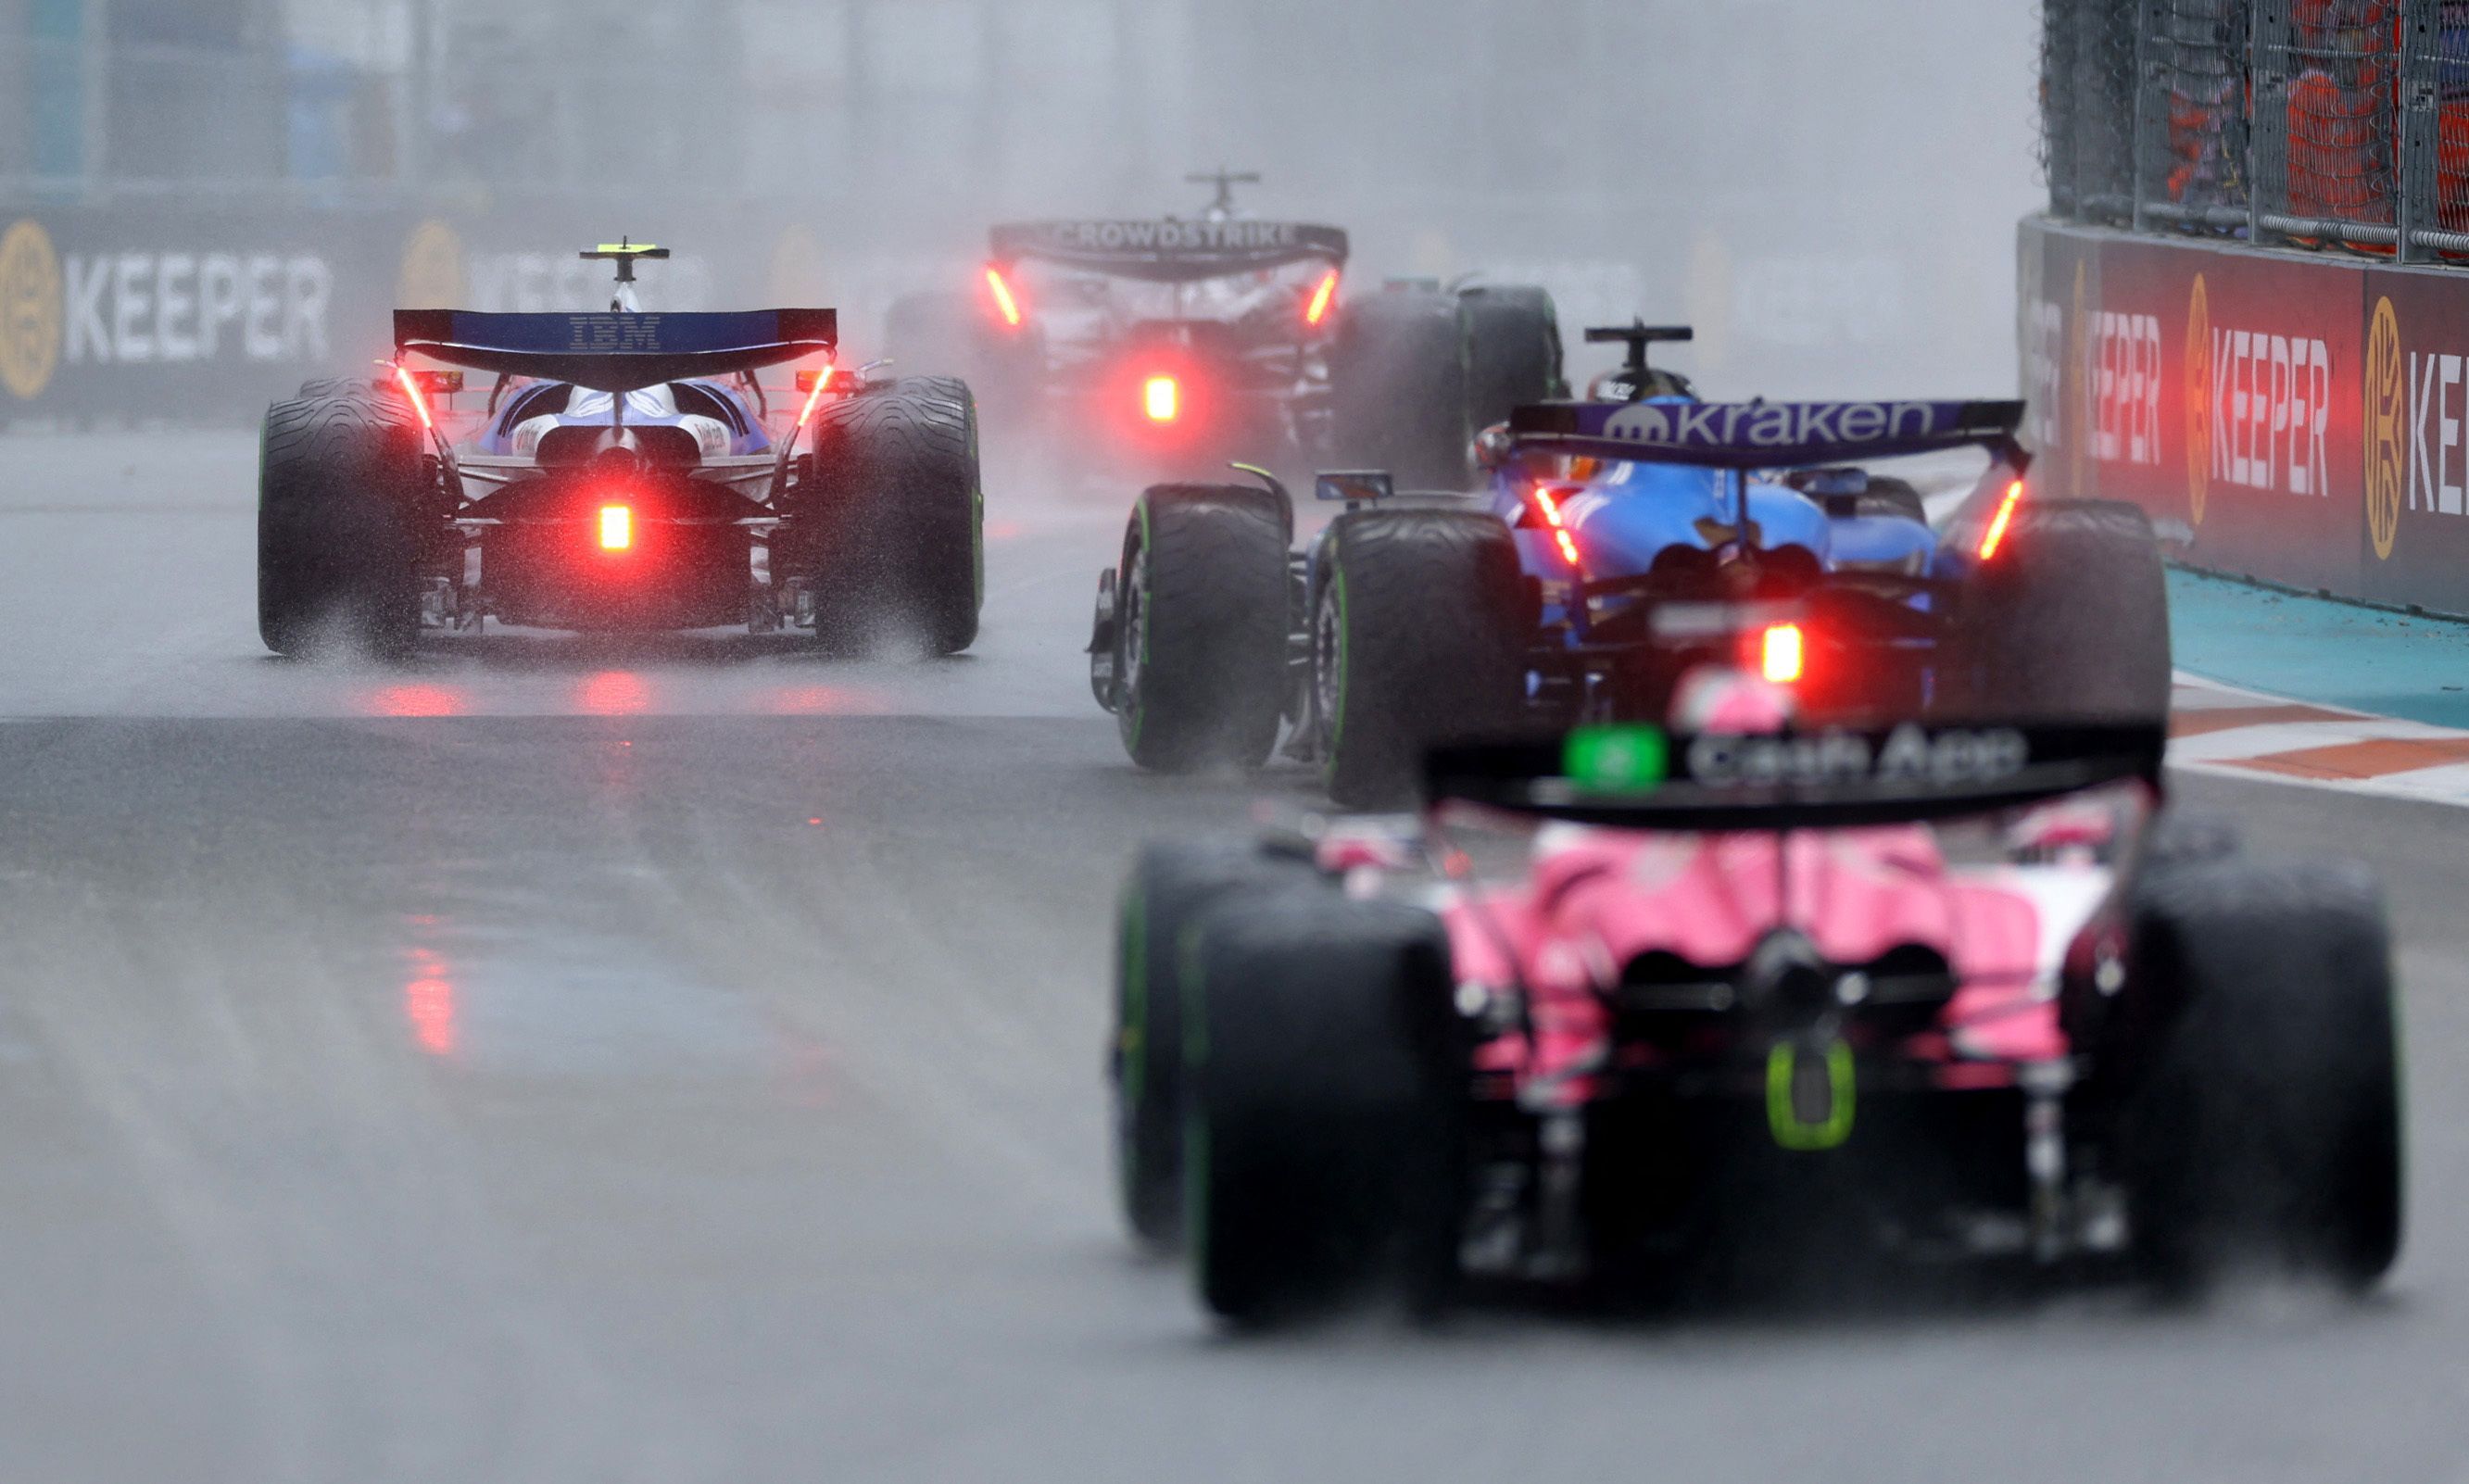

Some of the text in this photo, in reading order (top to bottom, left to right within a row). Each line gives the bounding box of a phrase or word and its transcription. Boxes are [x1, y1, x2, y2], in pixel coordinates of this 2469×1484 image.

[63, 252, 332, 361] KEEPER
[569, 316, 661, 349] IBM
[1677, 402, 1934, 446] kraken
[2211, 327, 2330, 497] KEEPER
[2409, 351, 2469, 516] KE
[1877, 722, 2032, 786] App
